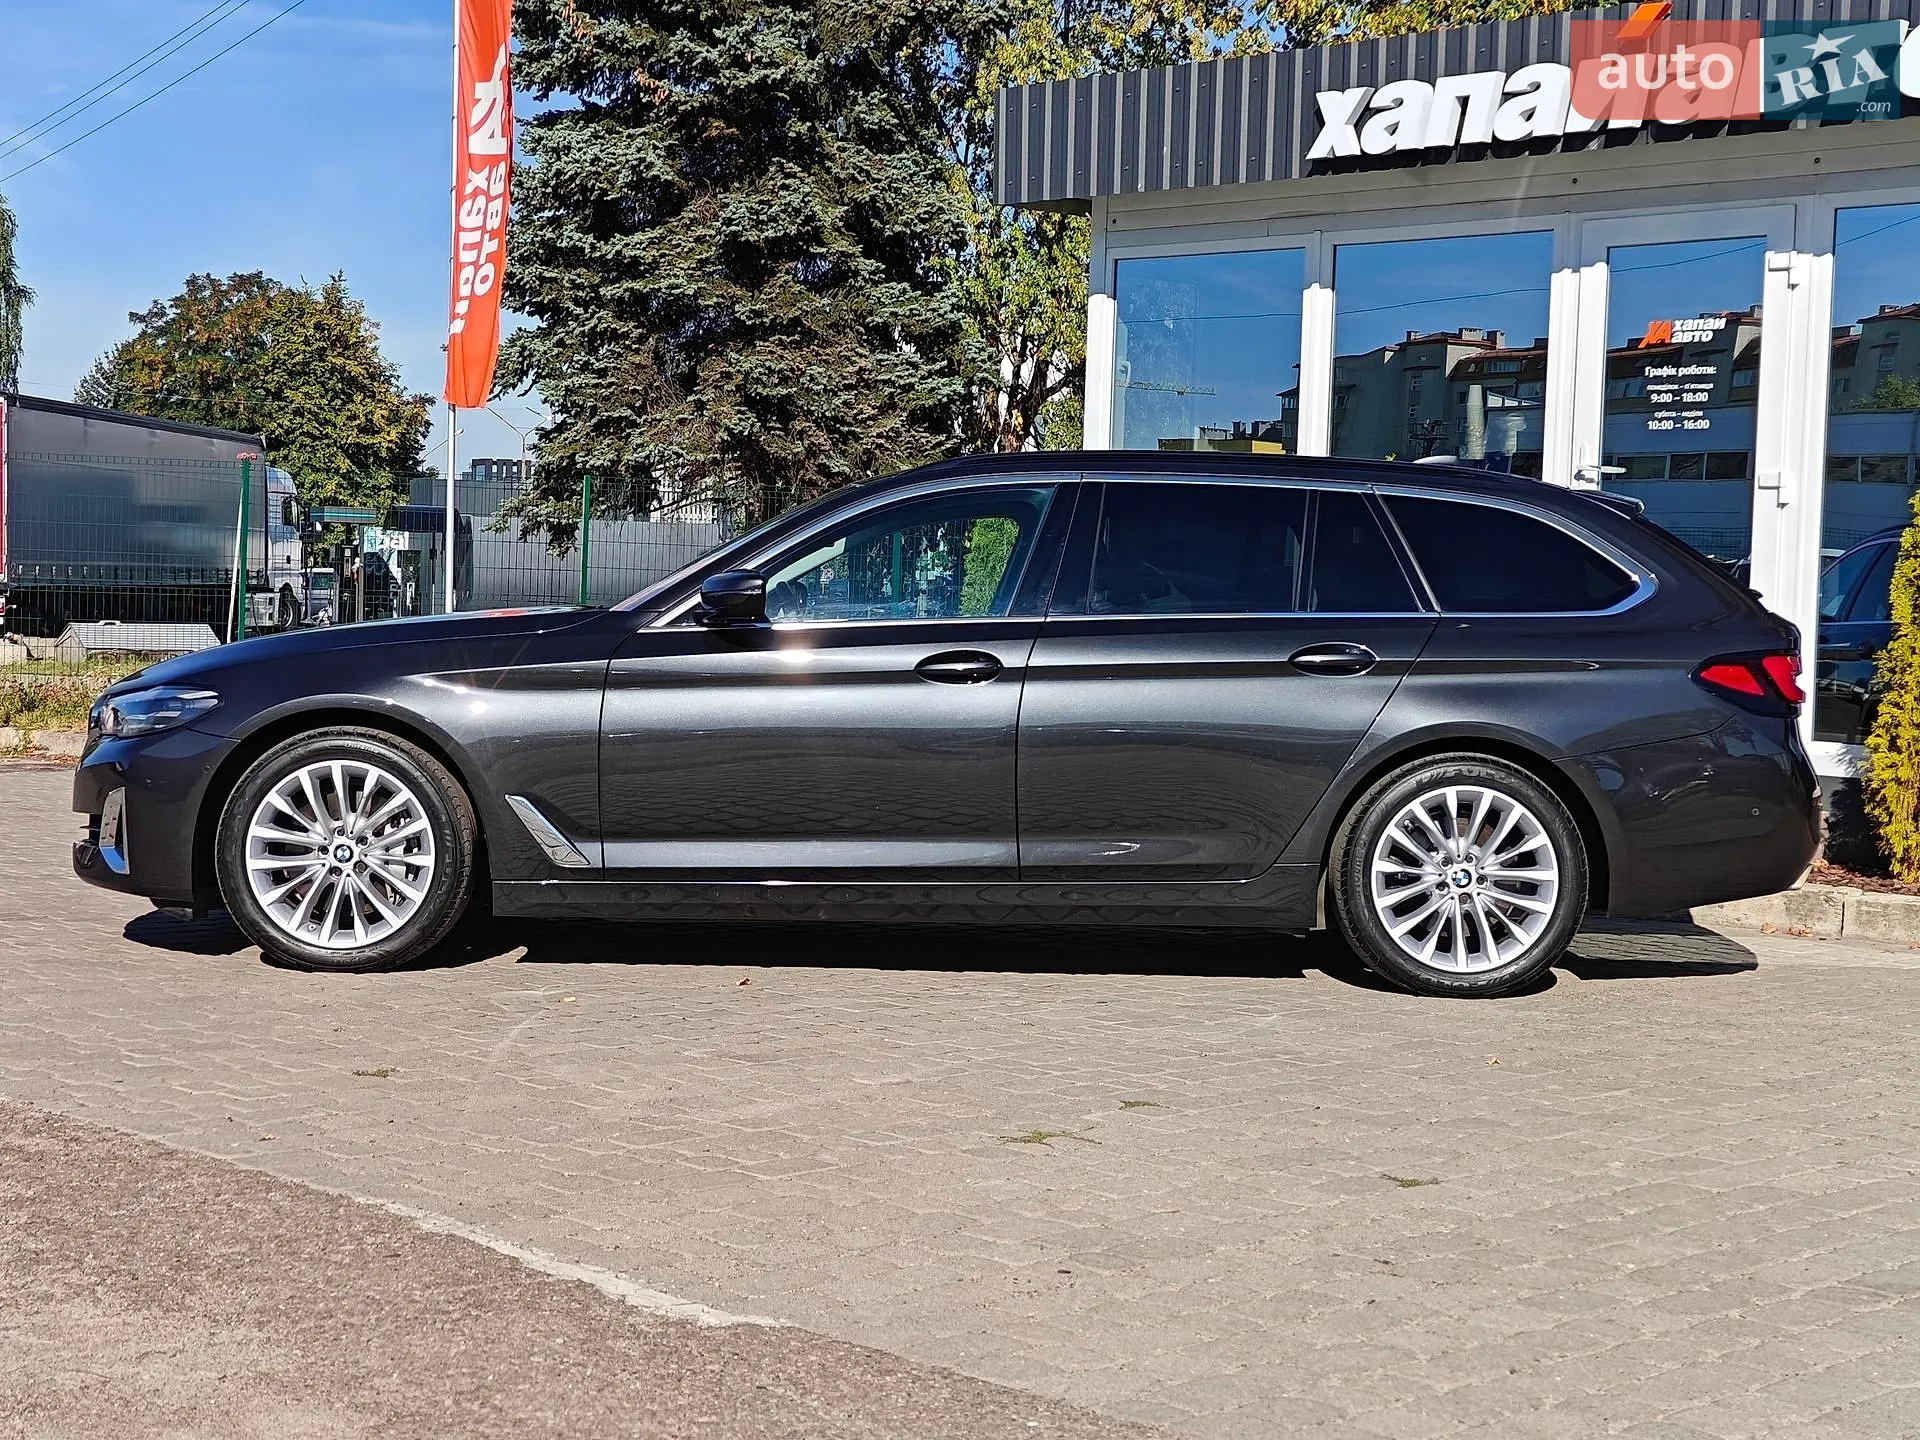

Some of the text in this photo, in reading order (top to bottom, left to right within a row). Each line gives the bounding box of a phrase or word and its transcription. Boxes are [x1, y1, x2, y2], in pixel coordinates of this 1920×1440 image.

[1672, 313, 1728, 331] хапай
[1671, 331, 1714, 343] авто
[1644, 365, 1717, 378] Графік роботи:
[1650, 393, 1673, 403] 9:00
[1681, 392, 1709, 402] 18:00
[1647, 420, 1674, 430] 10:00
[1683, 419, 1710, 430] 16:00
